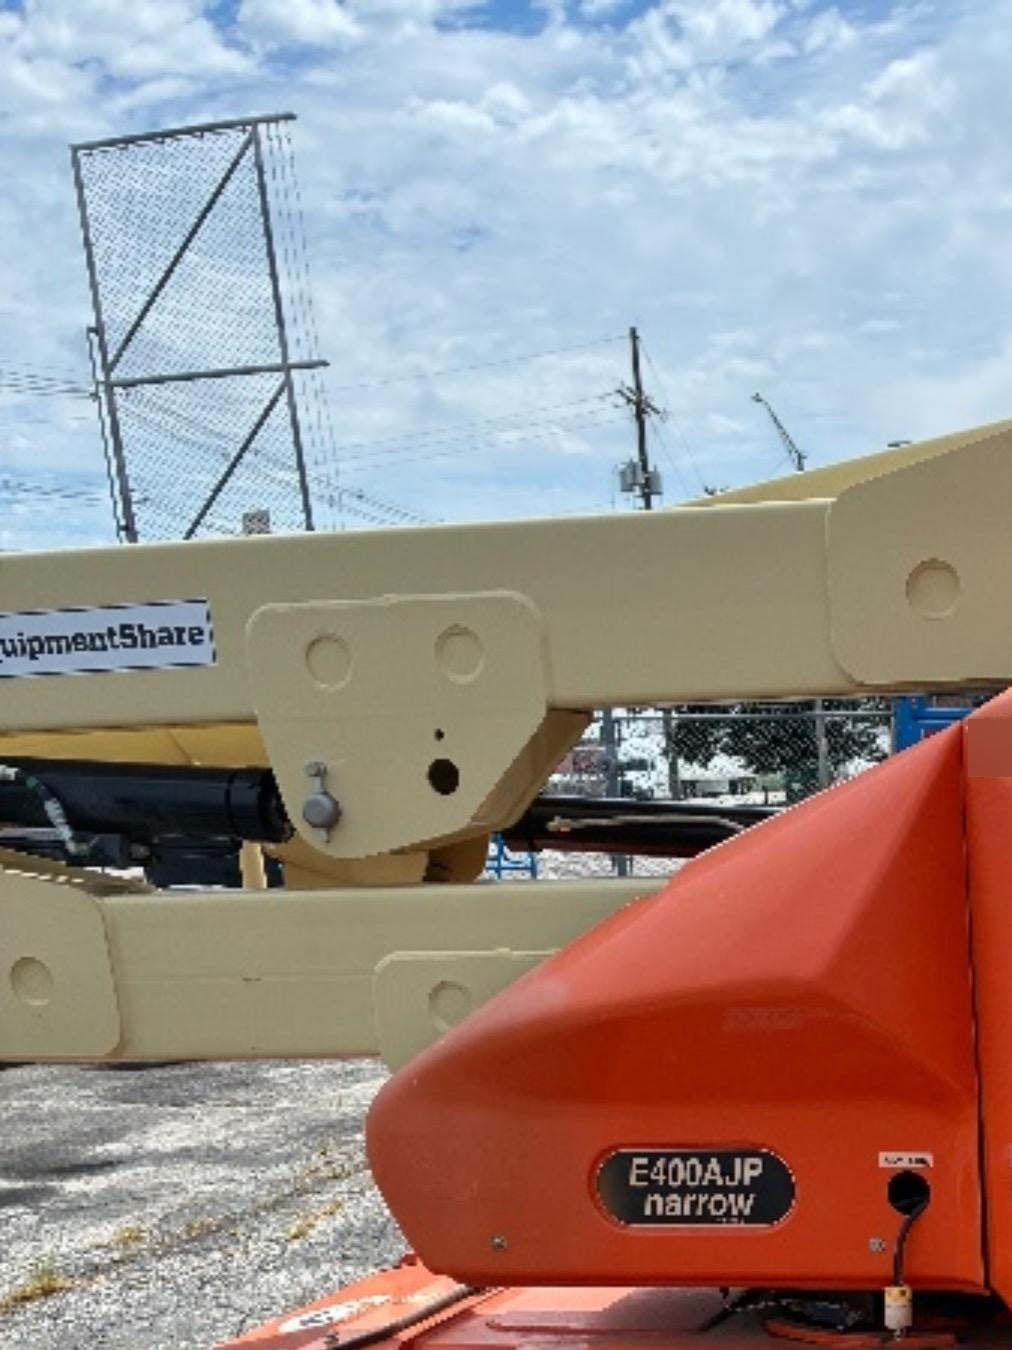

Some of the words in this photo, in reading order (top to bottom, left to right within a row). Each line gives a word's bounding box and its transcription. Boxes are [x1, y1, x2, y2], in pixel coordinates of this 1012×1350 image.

[0, 624, 204, 664] uipmentShare
[629, 1156, 764, 1187] E400AJP
[643, 1192, 754, 1217] narrow
